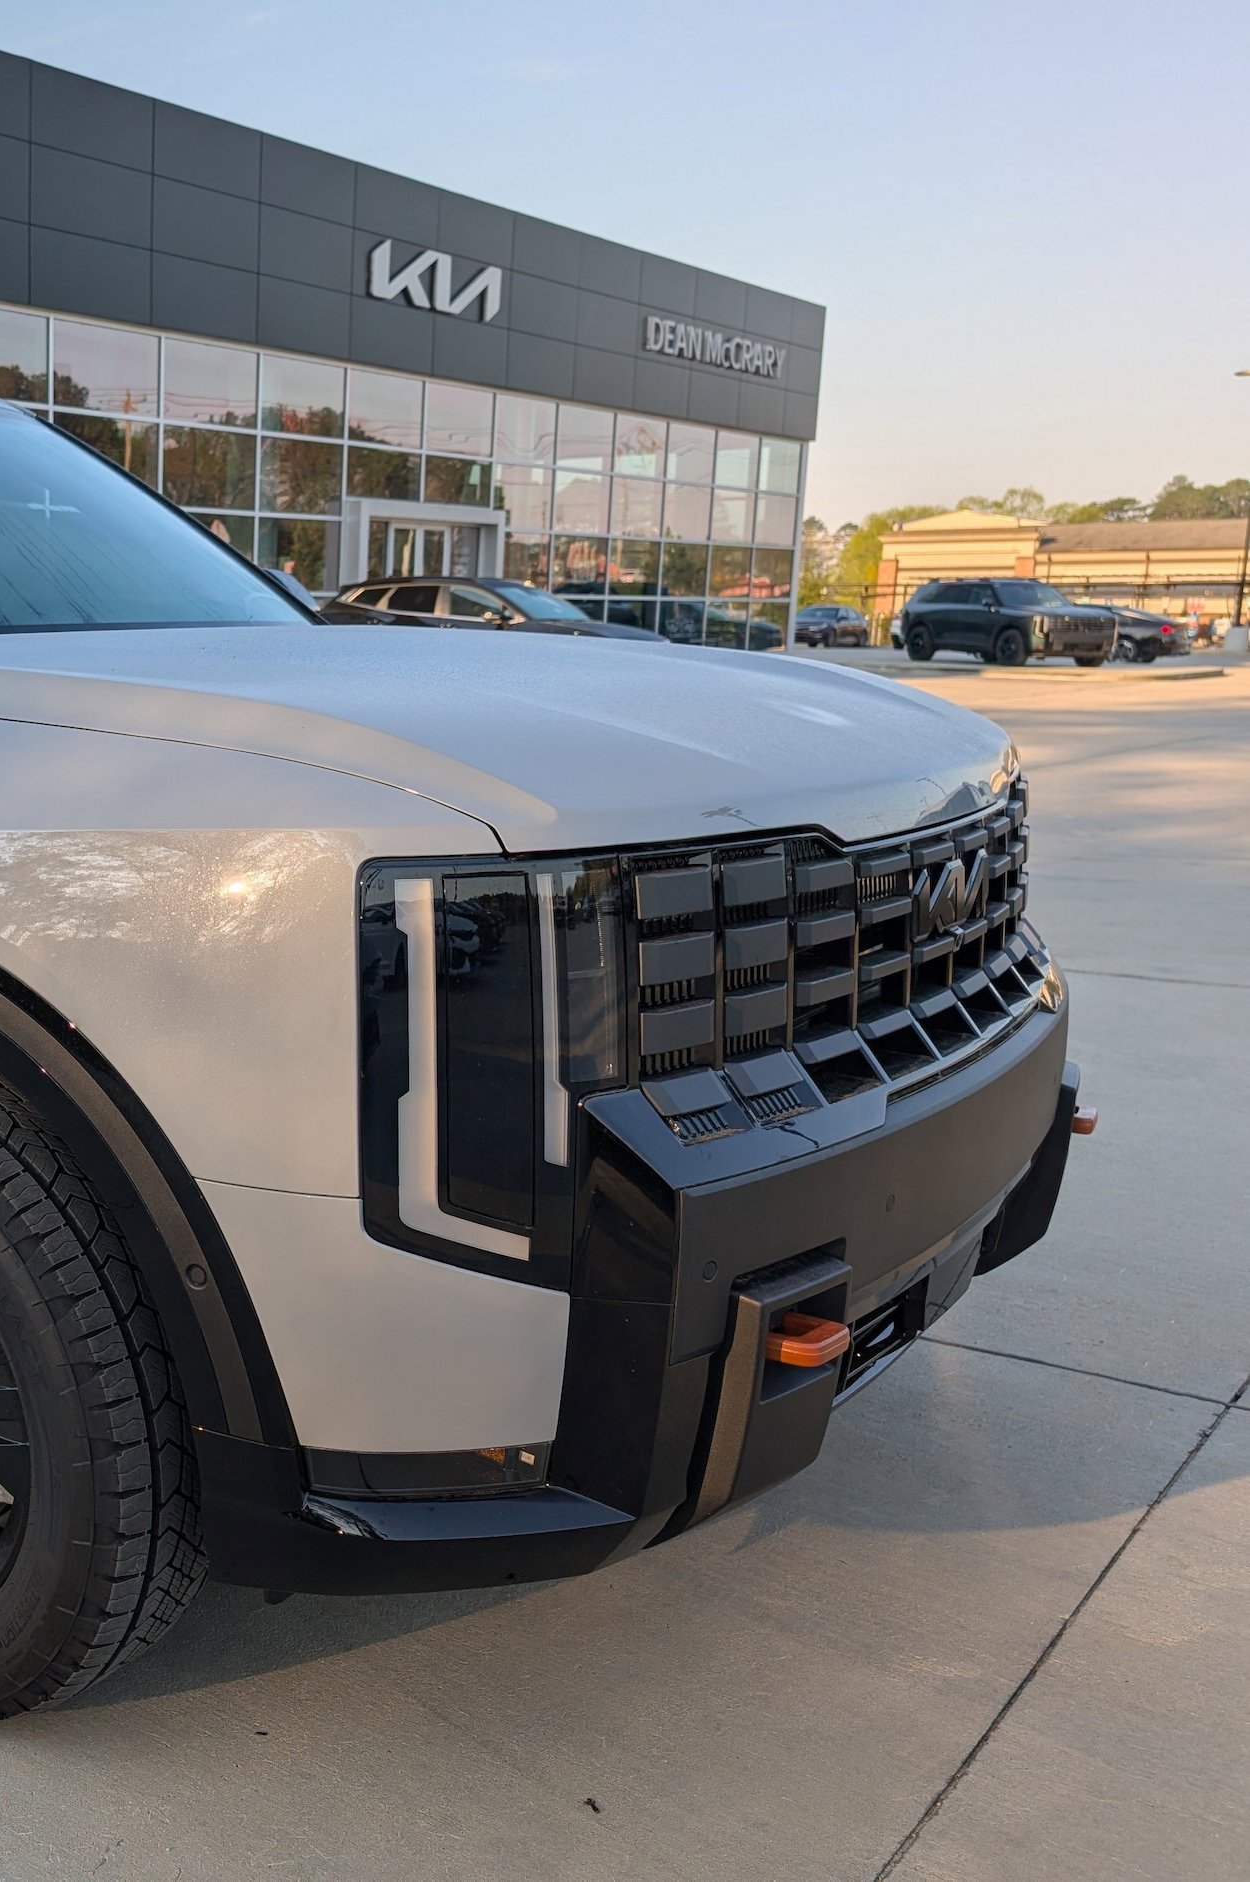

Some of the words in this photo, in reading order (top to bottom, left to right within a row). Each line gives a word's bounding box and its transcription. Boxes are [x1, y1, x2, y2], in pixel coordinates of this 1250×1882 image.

[369, 238, 503, 323] KIA
[646, 316, 703, 361] DEAN
[911, 847, 990, 943] KIA
